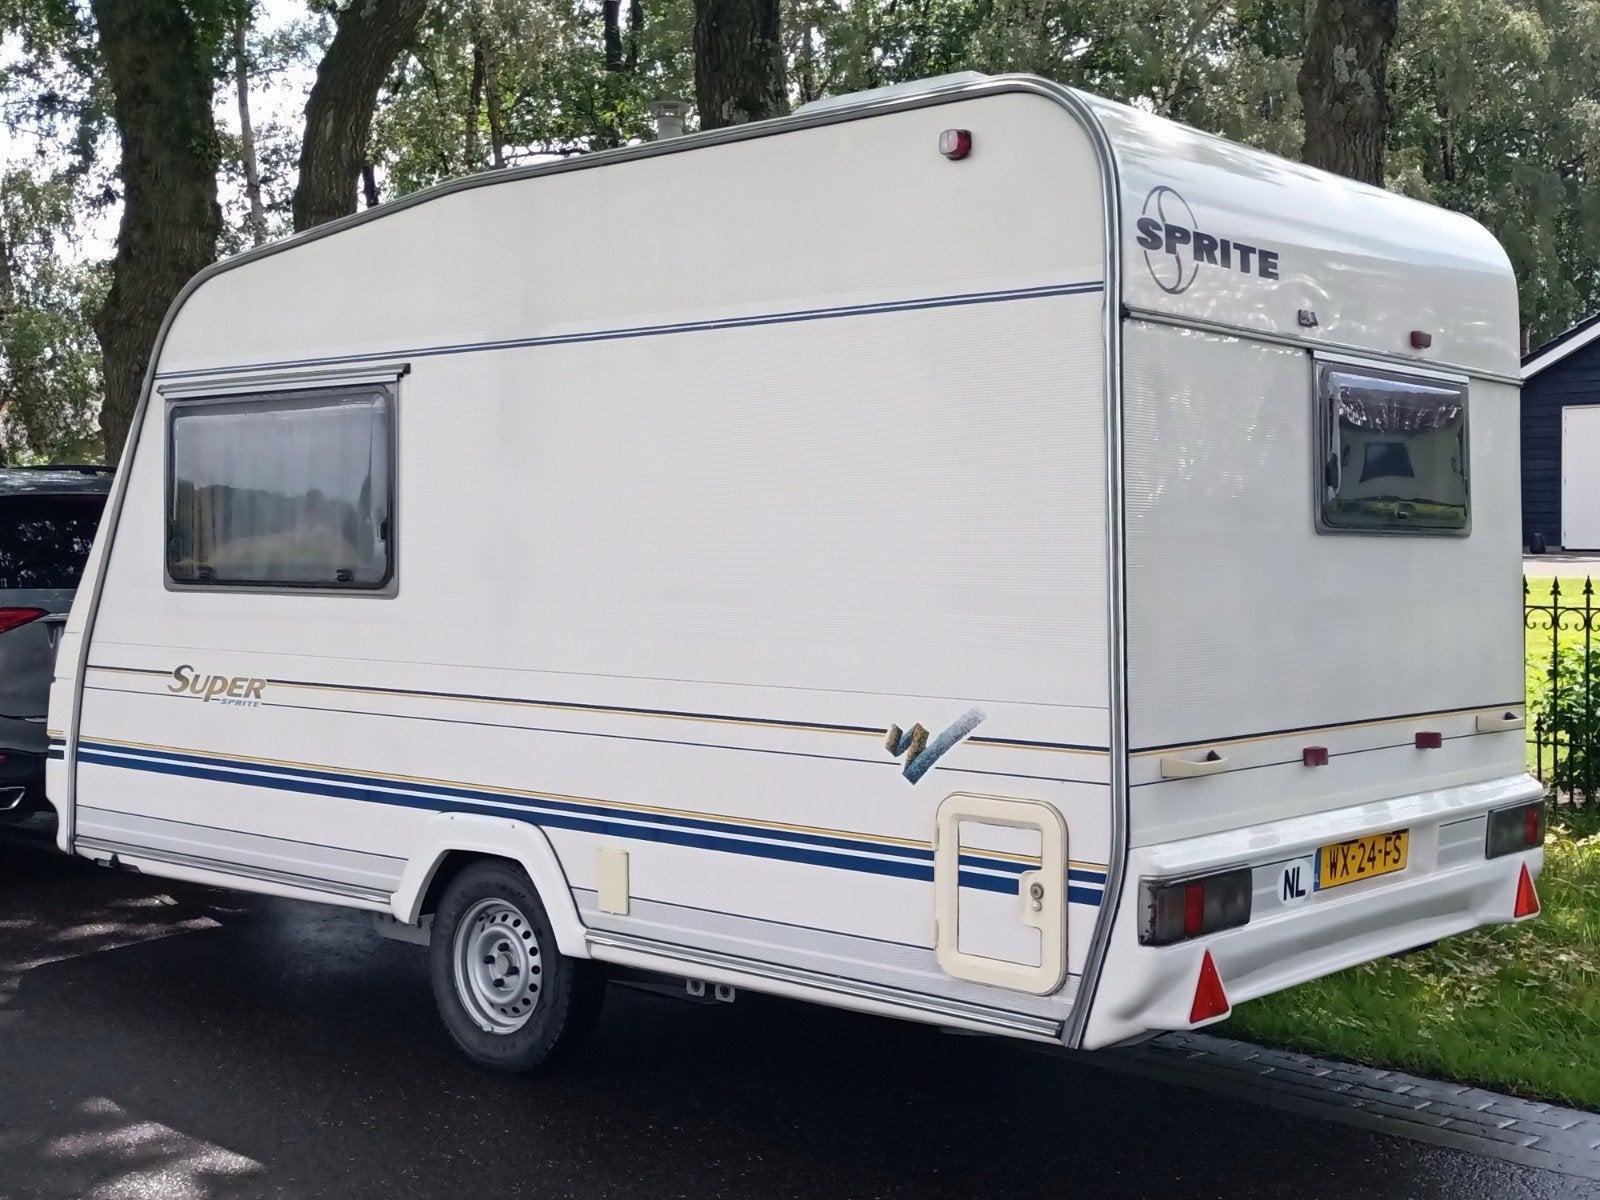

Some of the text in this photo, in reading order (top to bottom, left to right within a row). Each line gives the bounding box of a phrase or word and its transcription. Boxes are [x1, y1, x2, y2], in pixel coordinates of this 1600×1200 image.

[1136, 217, 1279, 281] SPRITE
[220, 698, 260, 708] SPRITE
[1329, 834, 1402, 880] WX-24-FS
[1283, 866, 1306, 901] NL
